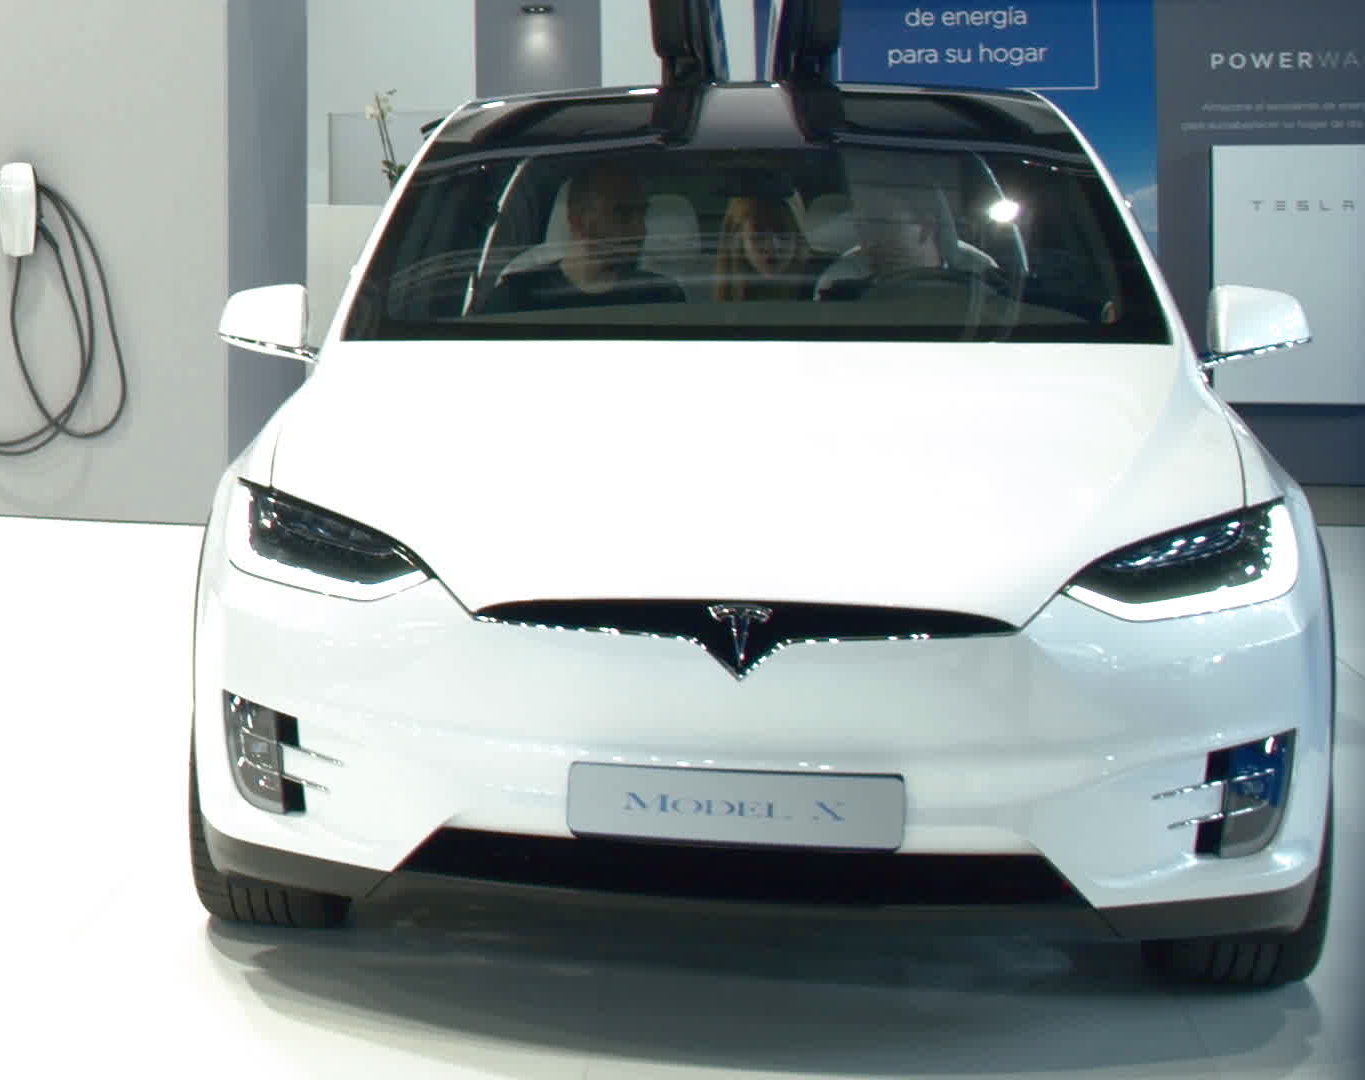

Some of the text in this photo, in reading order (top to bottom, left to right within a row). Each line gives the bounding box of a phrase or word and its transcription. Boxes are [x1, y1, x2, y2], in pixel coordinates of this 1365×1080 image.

[904, 9, 934, 27] de
[887, 42, 1047, 68] para su hogar
[1210, 51, 1365, 70] POWERWA
[1252, 200, 1357, 212] TESLA
[813, 800, 846, 821] X
